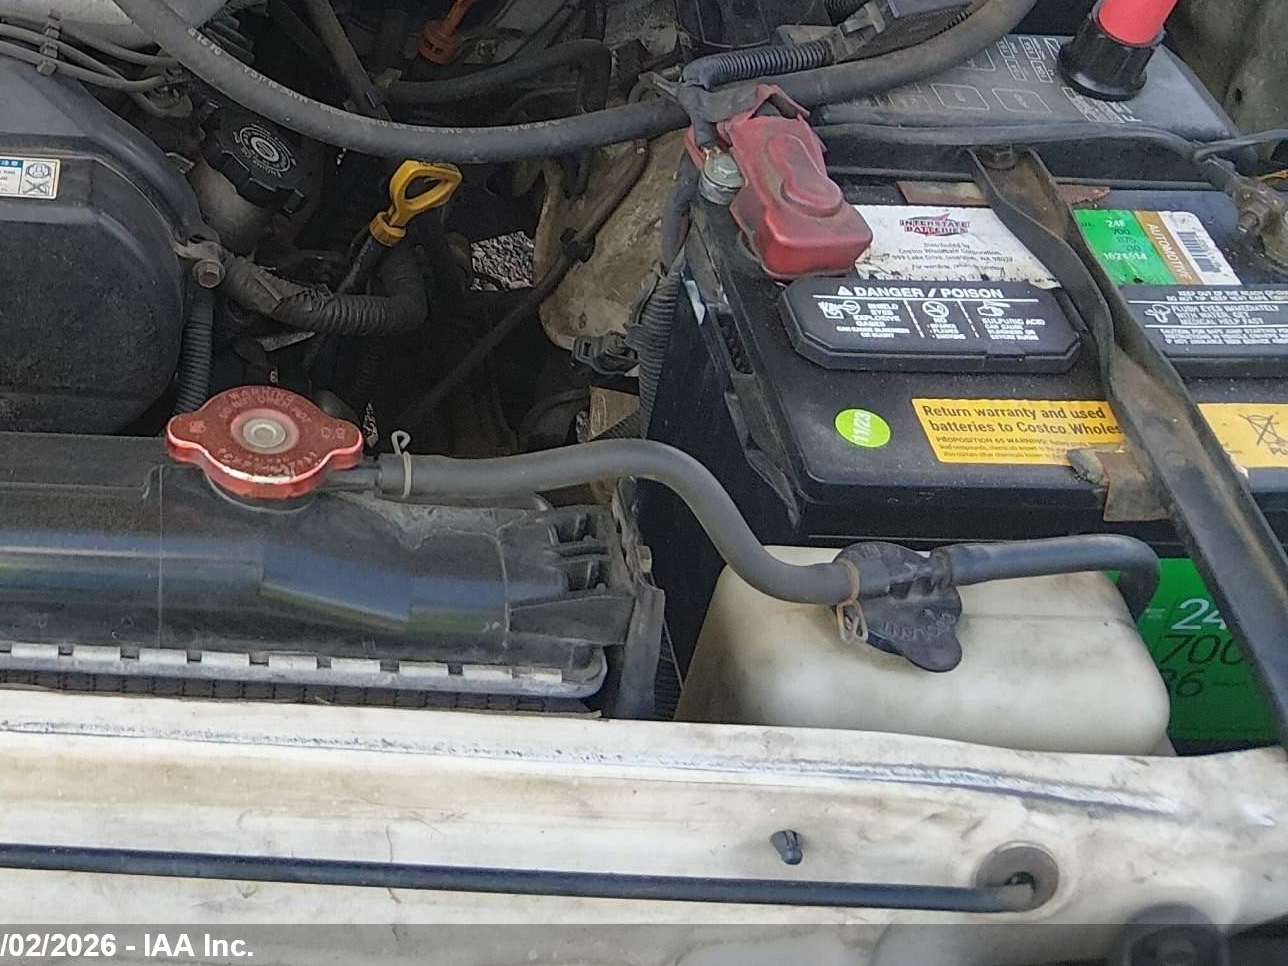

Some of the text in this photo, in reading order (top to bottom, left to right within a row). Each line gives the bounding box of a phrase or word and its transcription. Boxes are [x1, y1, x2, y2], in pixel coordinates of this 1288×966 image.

[899, 218, 970, 228] INTERSTATE
[1146, 223, 1193, 280] AUTOMOTIVE
[854, 286, 1004, 299] DANGER / POISON
[229, 387, 295, 403] WARNING
[923, 405, 1106, 420] Return warranty and used
[929, 420, 995, 433] batteries
[998, 421, 1013, 433] to
[1017, 422, 1067, 434] Costco
